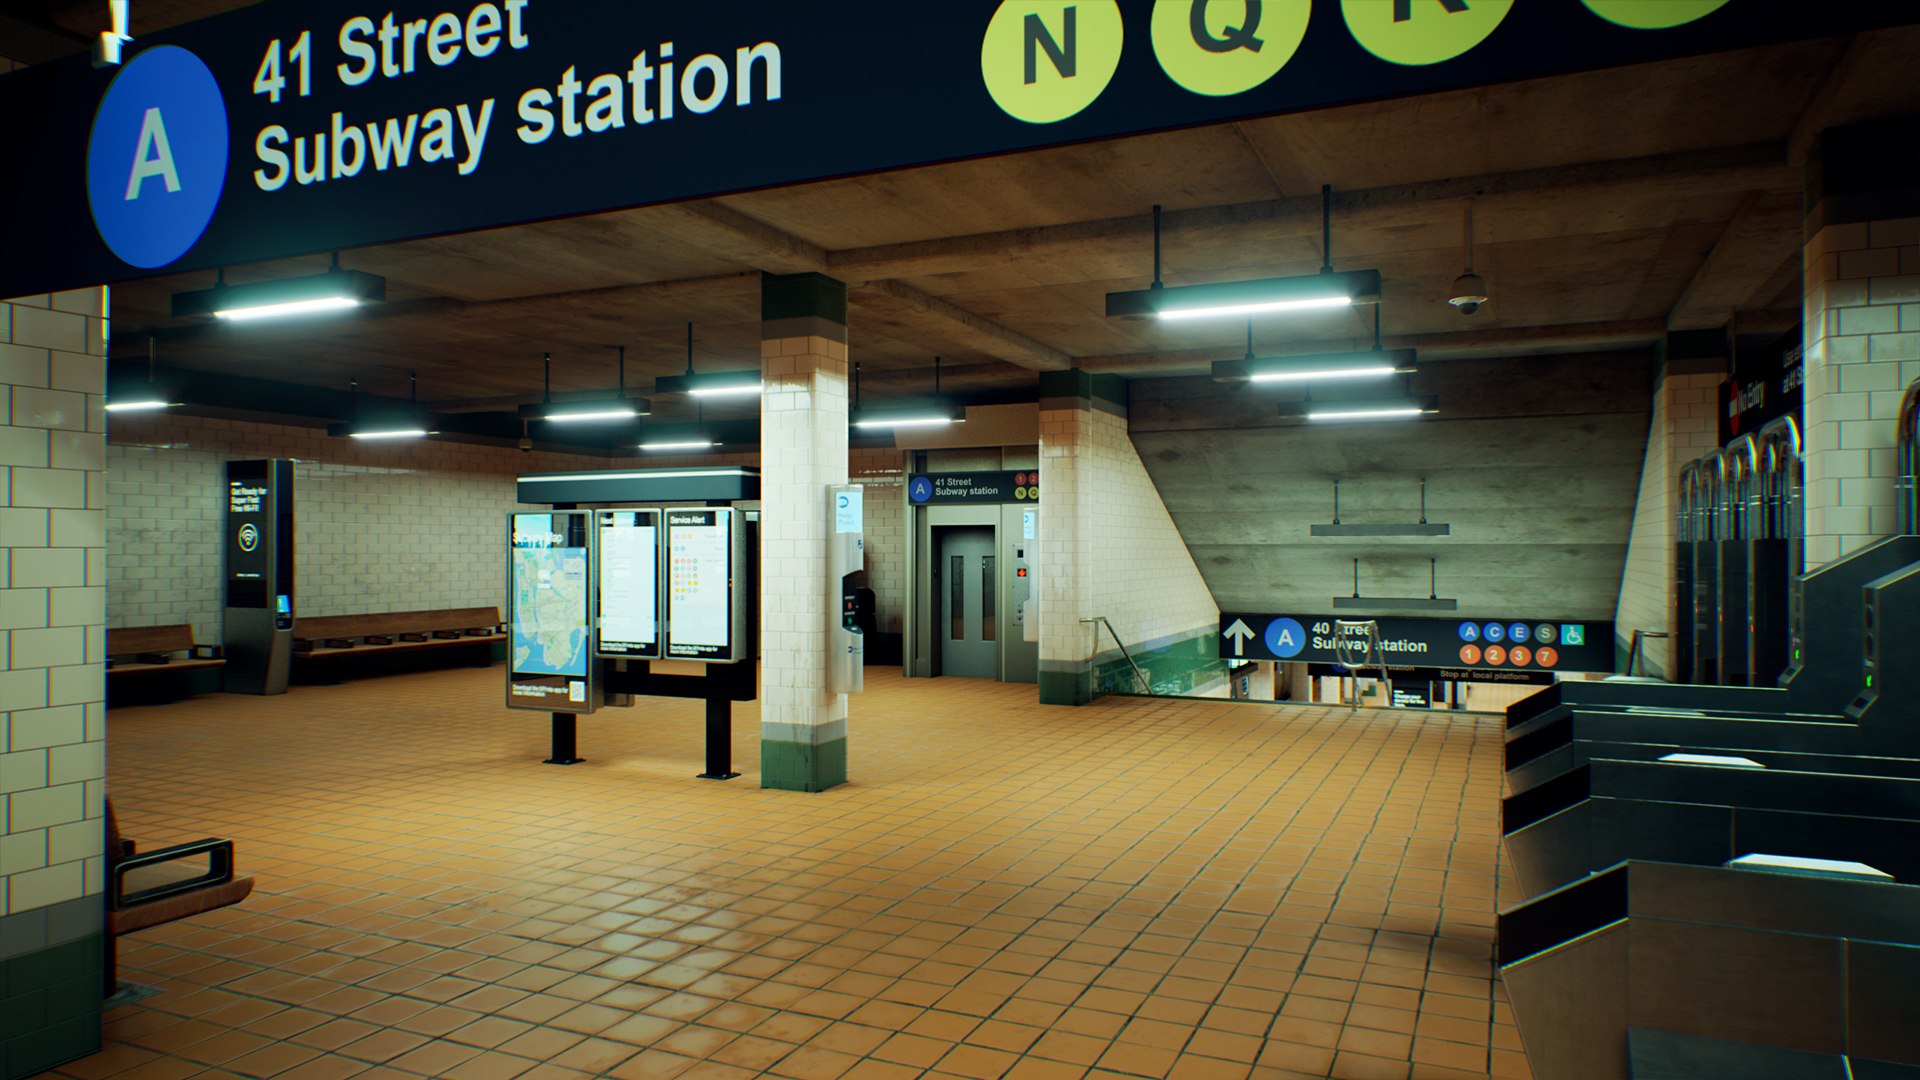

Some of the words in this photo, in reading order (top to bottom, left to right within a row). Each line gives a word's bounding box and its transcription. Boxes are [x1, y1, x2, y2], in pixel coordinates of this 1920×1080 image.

[1023, 5, 1077, 86] N
[1189, 0, 1265, 54] Q
[253, 31, 310, 103] 41
[337, 0, 529, 86] Street
[254, 99, 495, 191] Subway
[516, 42, 782, 144] station
[125, 107, 181, 201] A
[1738, 389, 1747, 414] No
[1747, 382, 1765, 409] Entry
[935, 478, 945, 486] 41
[947, 477, 972, 486] Street
[915, 483, 925, 494] A
[935, 487, 967, 497] Subway
[969, 486, 998, 495] station
[670, 516, 691, 525] Service
[691, 515, 705, 525] Alert
[1312, 621, 1330, 635] 40
[1335, 622, 1376, 635] tree
[1465, 626, 1476, 637] A
[1489, 626, 1500, 638] C
[1515, 627, 1525, 638] E
[1541, 627, 1551, 639] S
[1277, 628, 1295, 647] A
[1465, 650, 1472, 659] 1
[1490, 650, 1498, 660] 2
[1515, 650, 1523, 661] 3
[1542, 651, 1550, 662] 7
[1440, 670, 1459, 679] Stop
[1494, 673, 1530, 681] platform
